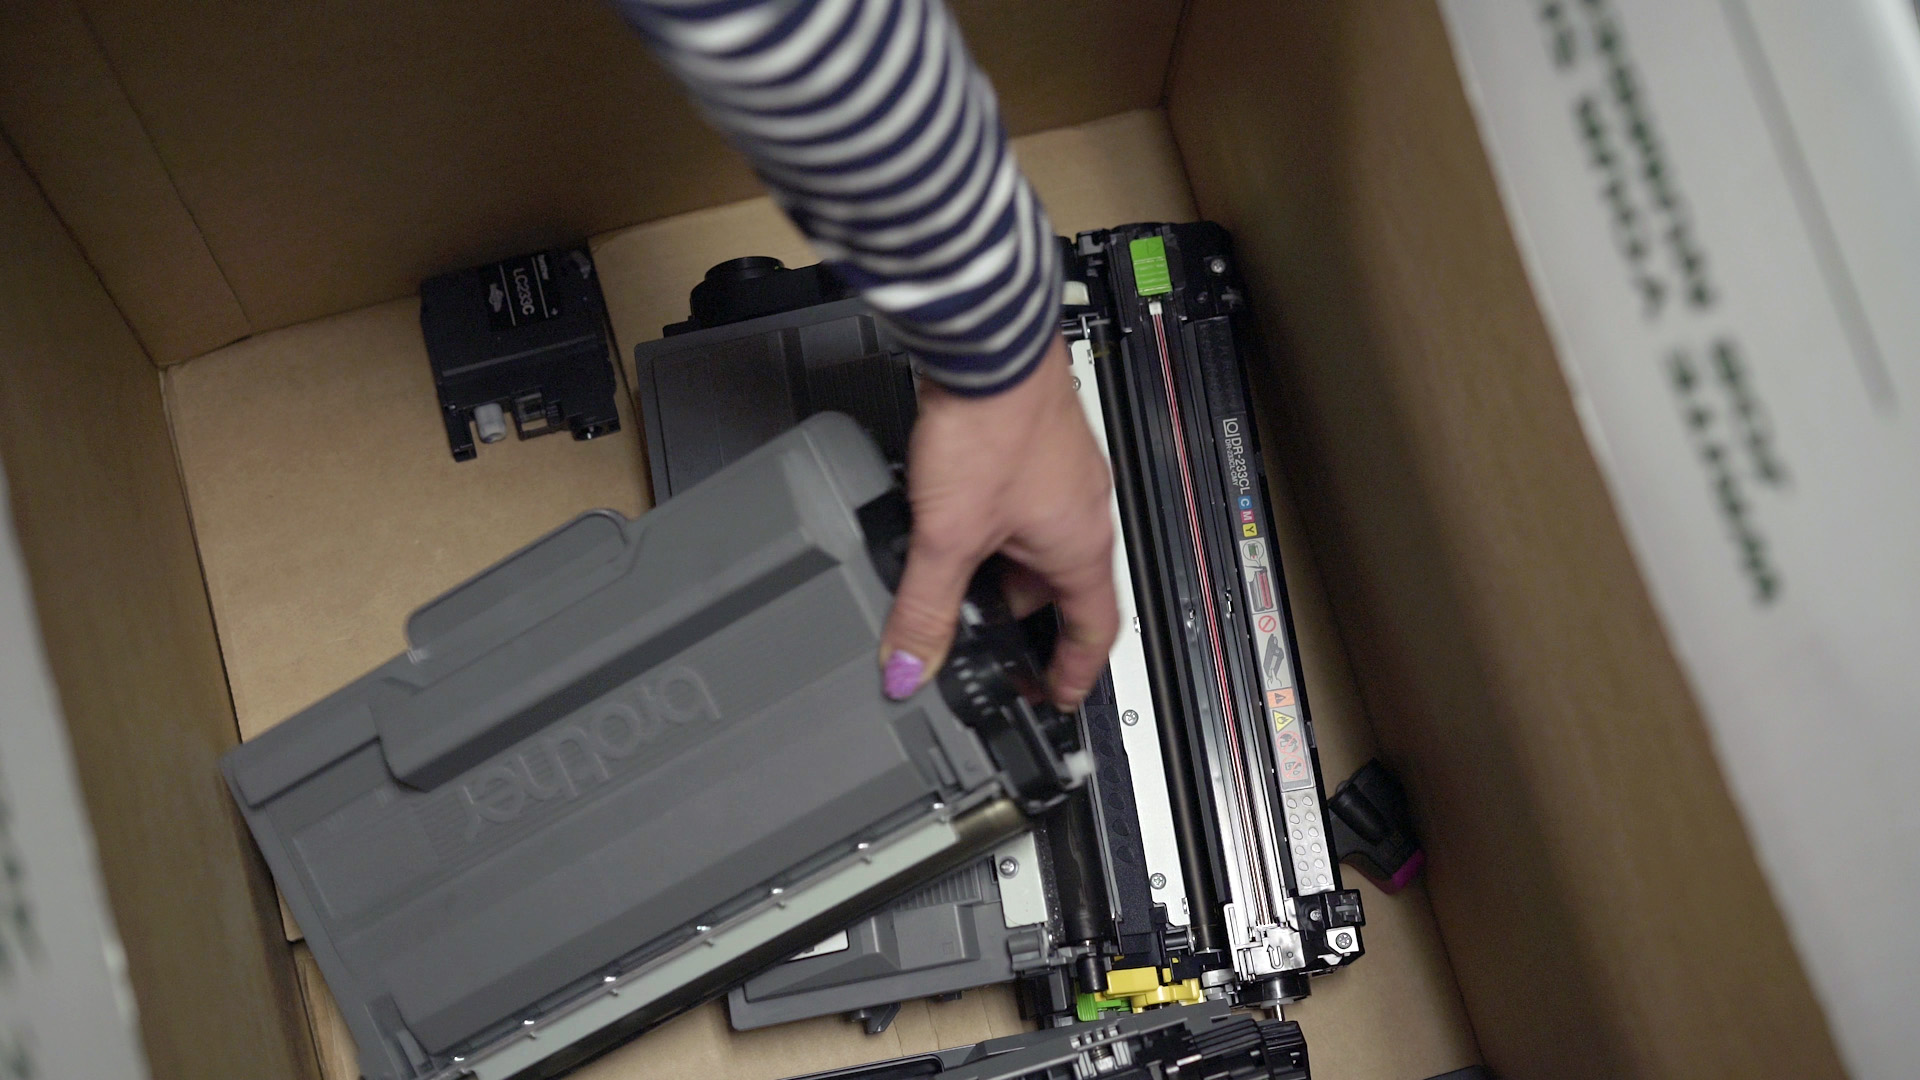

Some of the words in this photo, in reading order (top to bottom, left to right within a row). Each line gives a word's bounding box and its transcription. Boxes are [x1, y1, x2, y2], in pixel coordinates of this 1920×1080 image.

[1568, 93, 1665, 318] YOUR
[1580, 0, 1715, 308] NUMBE
[513, 267, 535, 315] LC233C
[1231, 437, 1251, 495] DR-233CL
[1243, 510, 1253, 521] M
[1664, 347, 1782, 606] WRITE
[1710, 337, 1788, 488] JOB
[455, 665, 722, 842] brother
